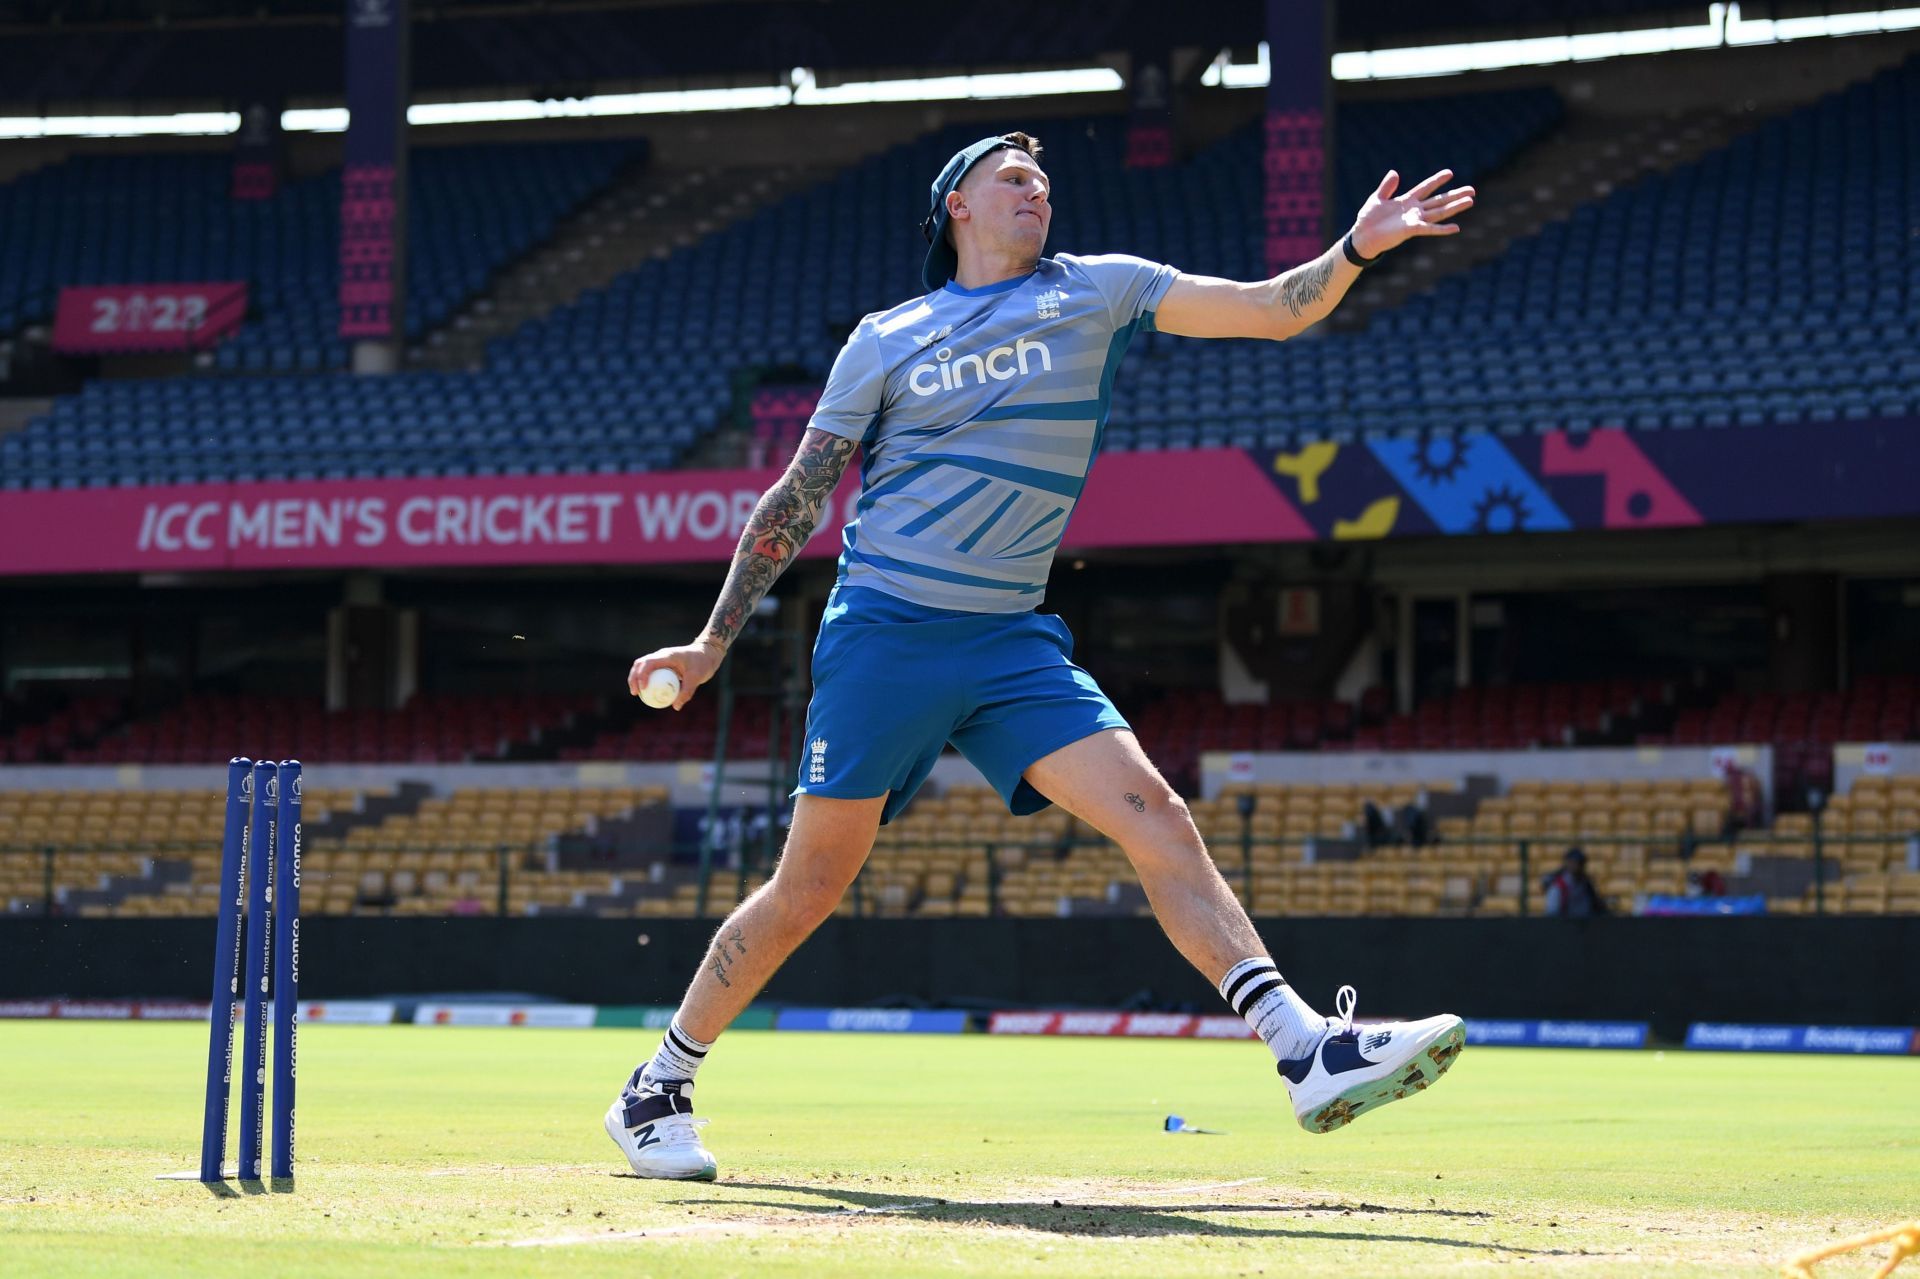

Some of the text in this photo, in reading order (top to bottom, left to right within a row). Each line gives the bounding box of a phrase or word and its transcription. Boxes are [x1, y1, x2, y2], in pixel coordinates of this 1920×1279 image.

[909, 337, 1052, 397] cinch
[138, 501, 221, 550] ICC
[228, 497, 387, 548] MEN'S
[396, 493, 622, 546] CRICKET
[267, 821, 276, 884] mastercard
[293, 823, 302, 888] aramco
[233, 913, 243, 975] mastercard
[263, 910, 272, 974] mastercard
[291, 918, 300, 983] aramco
[259, 1001, 268, 1066] mastercard
[255, 1093, 264, 1157] mastercard
